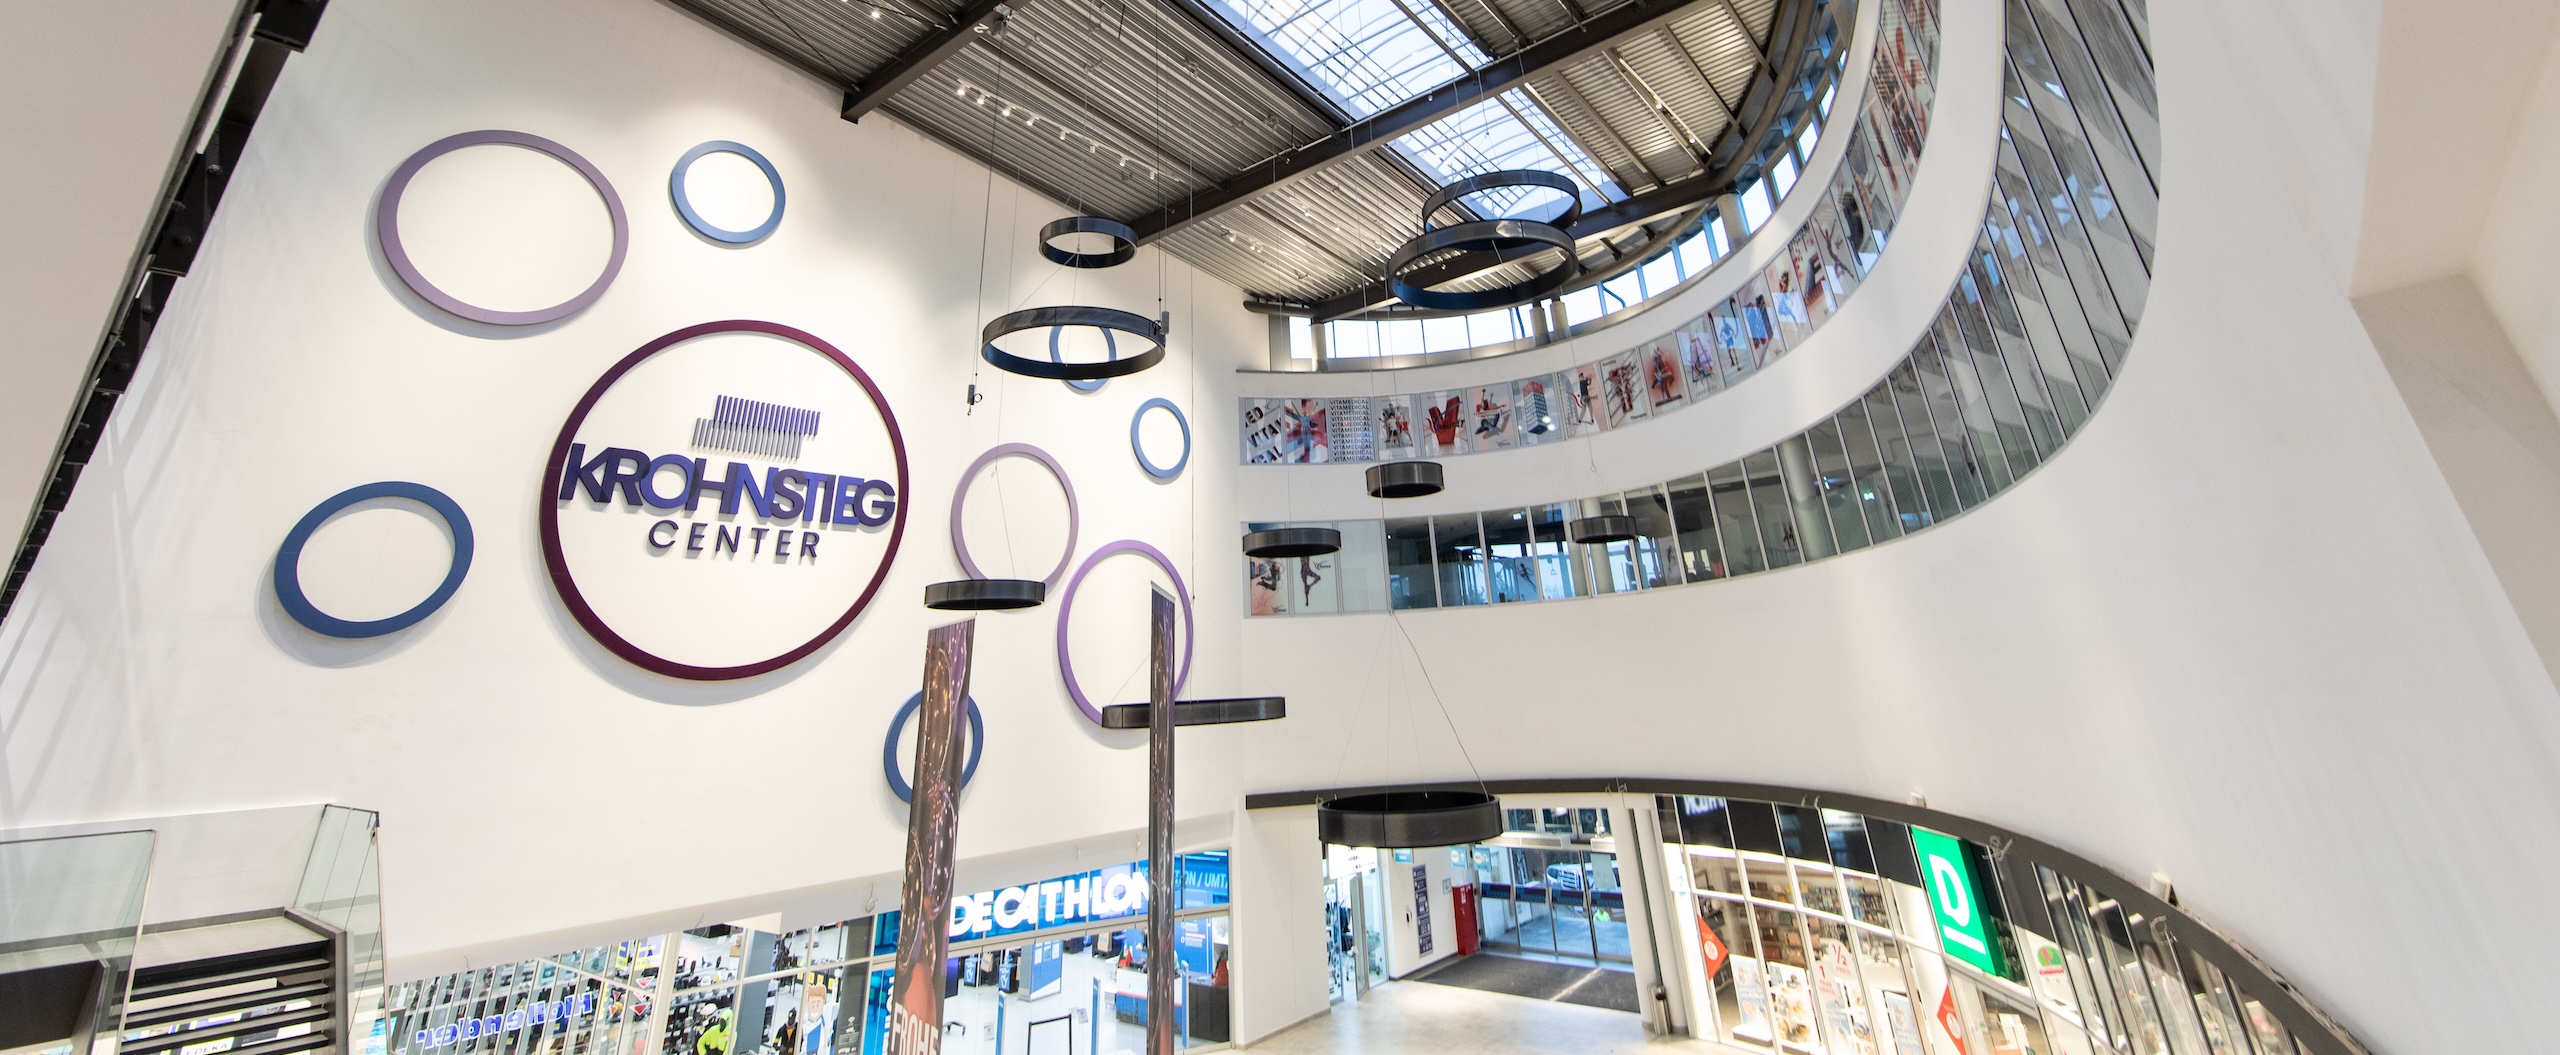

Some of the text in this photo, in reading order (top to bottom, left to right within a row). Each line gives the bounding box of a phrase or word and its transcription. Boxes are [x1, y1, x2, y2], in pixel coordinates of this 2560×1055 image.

[559, 442, 896, 527] KROHNSTIEG
[648, 520, 820, 558] CENTER
[949, 871, 1149, 938] DECATHLON
[1928, 853, 1971, 927] D
